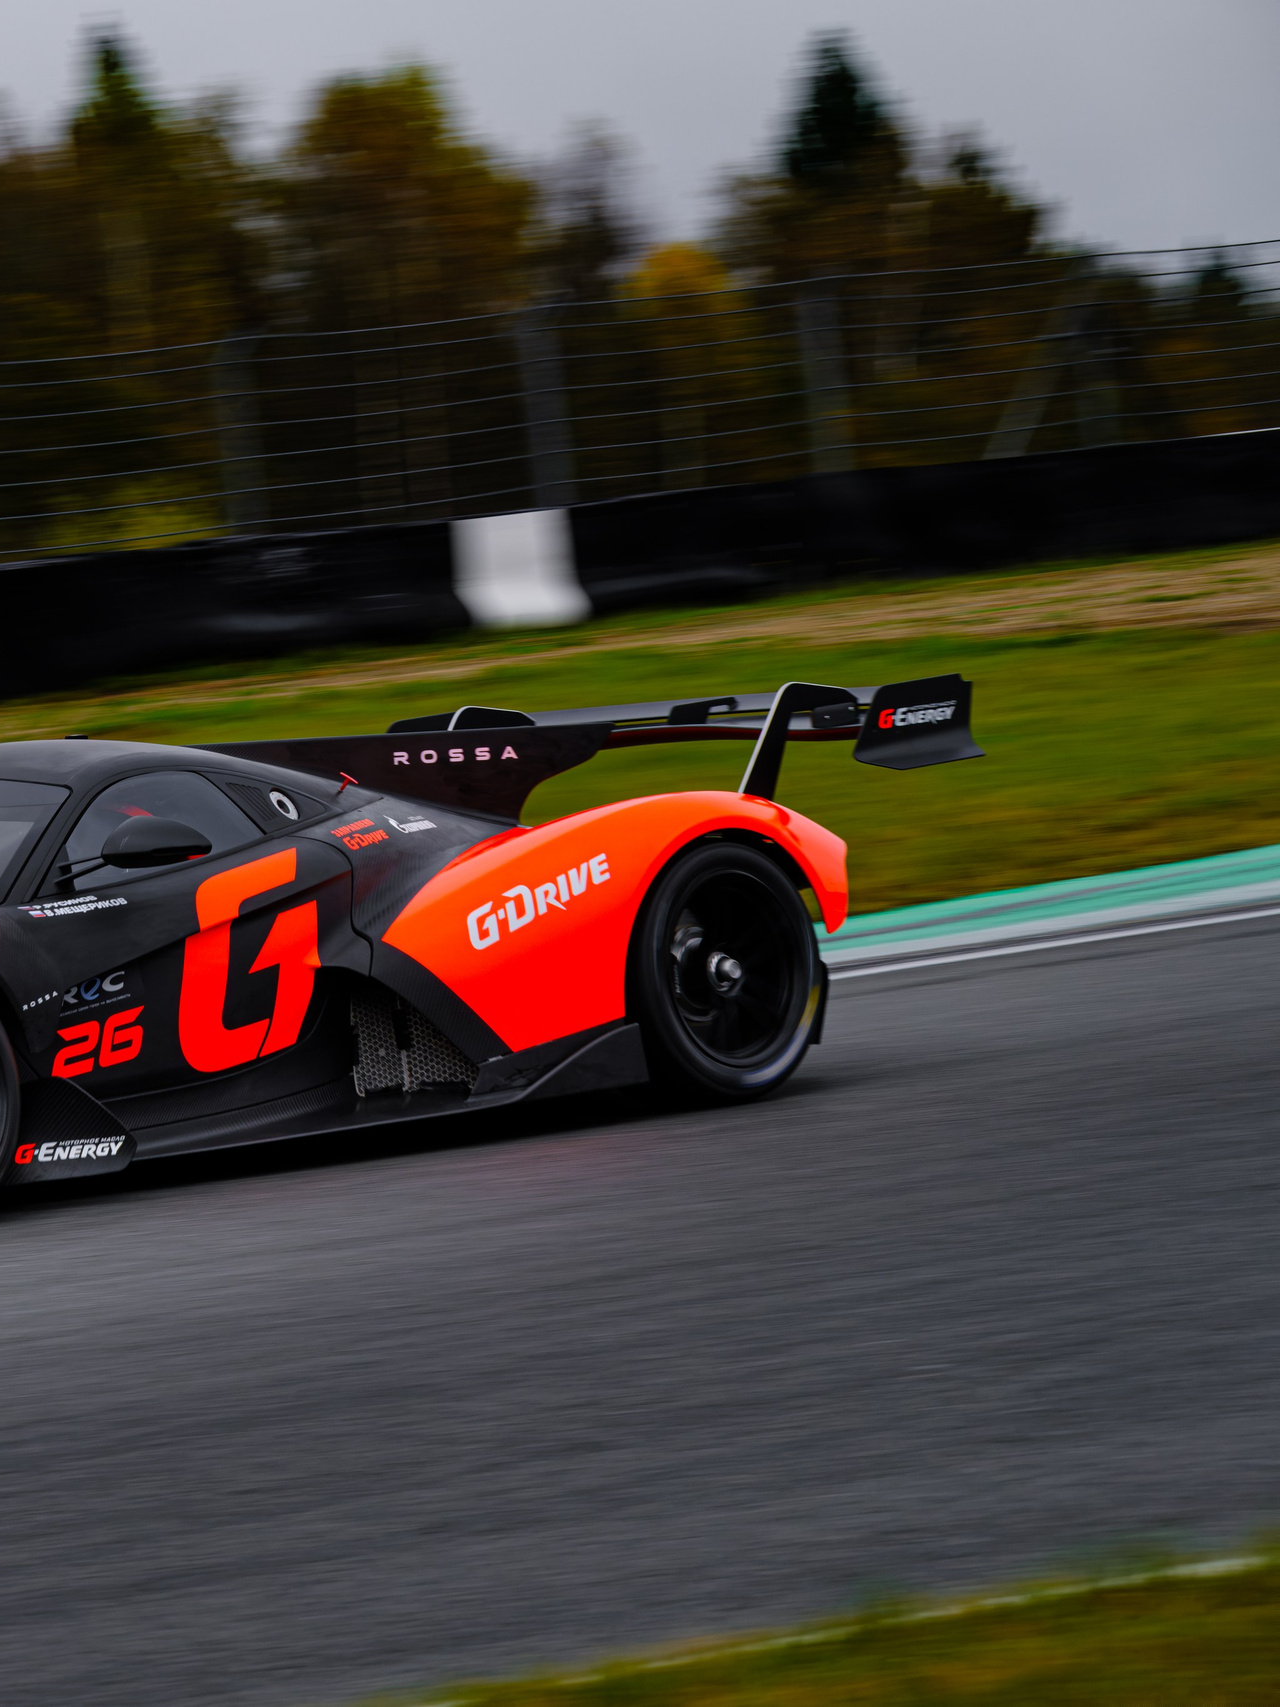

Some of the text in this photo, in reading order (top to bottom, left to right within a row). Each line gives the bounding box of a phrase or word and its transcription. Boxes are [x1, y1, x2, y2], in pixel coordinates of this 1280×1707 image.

[393, 746, 519, 766] ROSSA
[178, 847, 321, 1073] G
[22, 990, 59, 1012] ROSSA
[51, 1005, 145, 1079] 26
